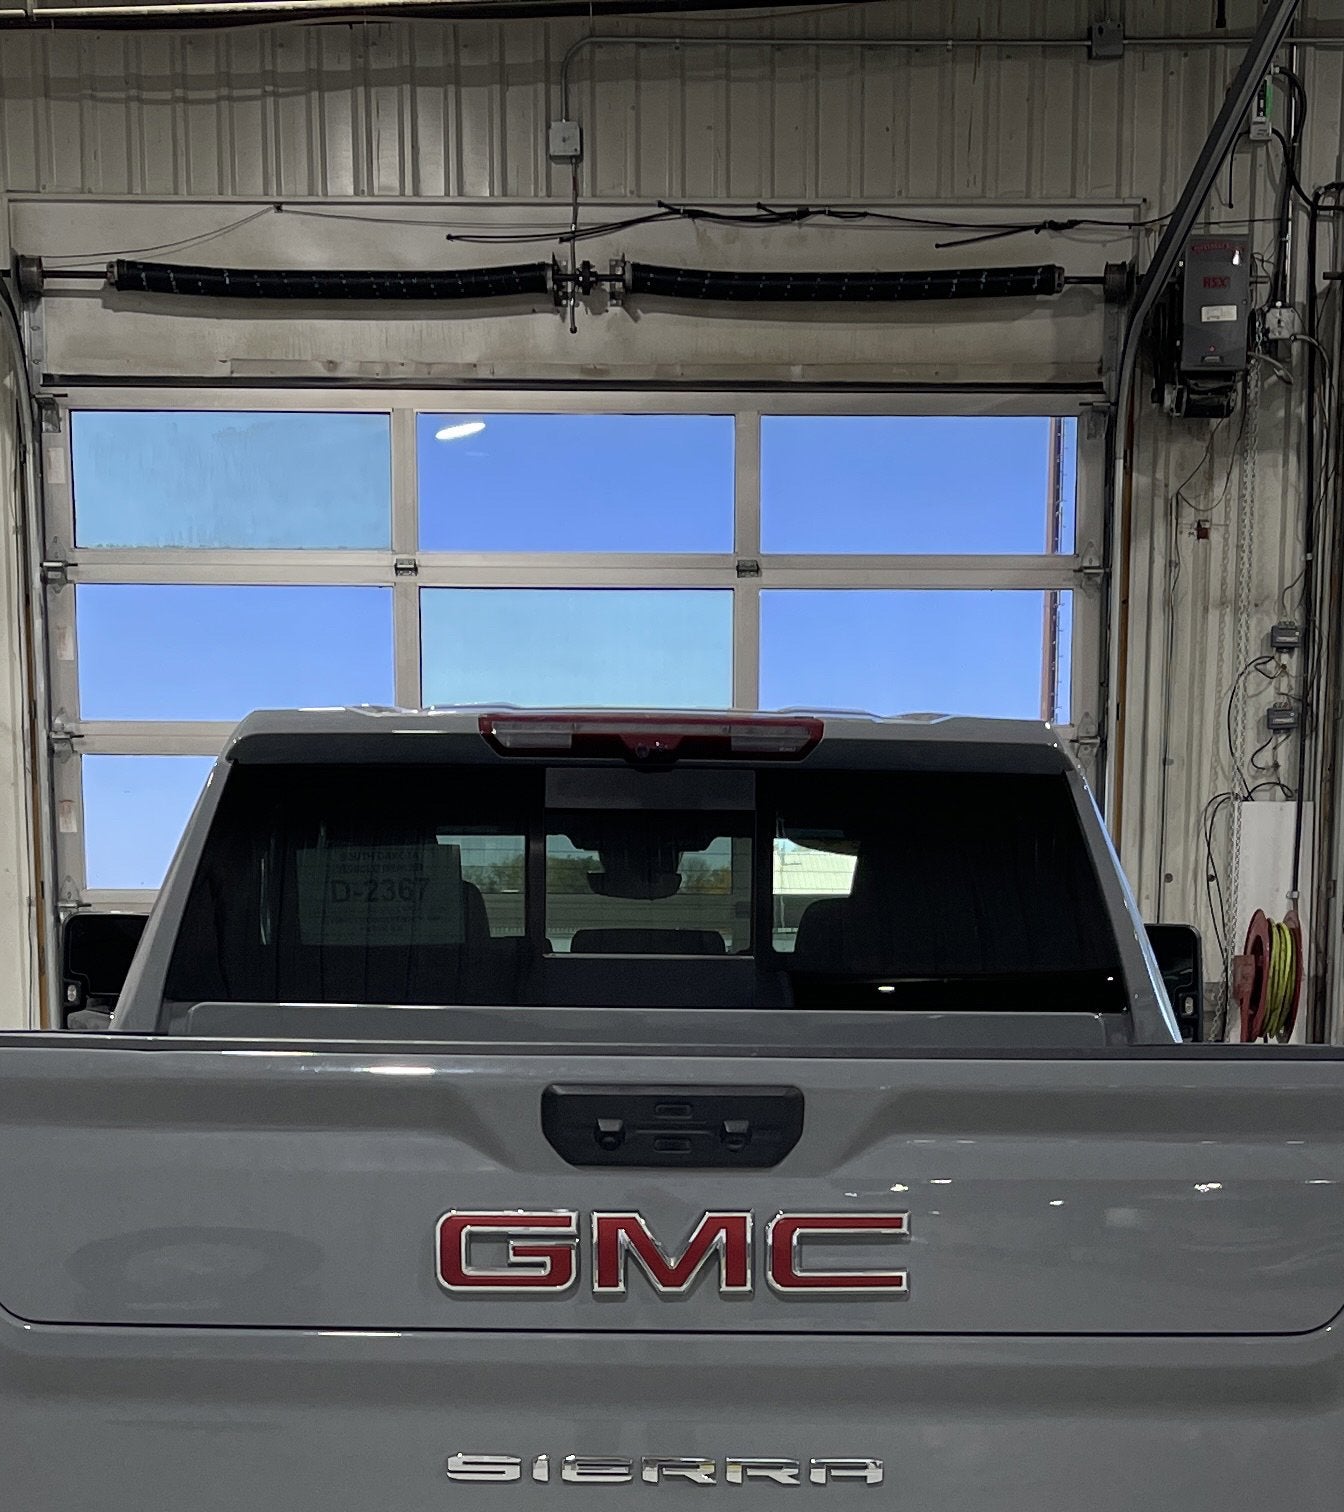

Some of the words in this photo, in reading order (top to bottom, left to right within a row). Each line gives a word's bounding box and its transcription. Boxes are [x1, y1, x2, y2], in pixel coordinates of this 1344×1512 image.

[331, 877, 430, 903] D-2367
[436, 1209, 911, 1294] GMC
[446, 1453, 885, 1485] SIERRA
